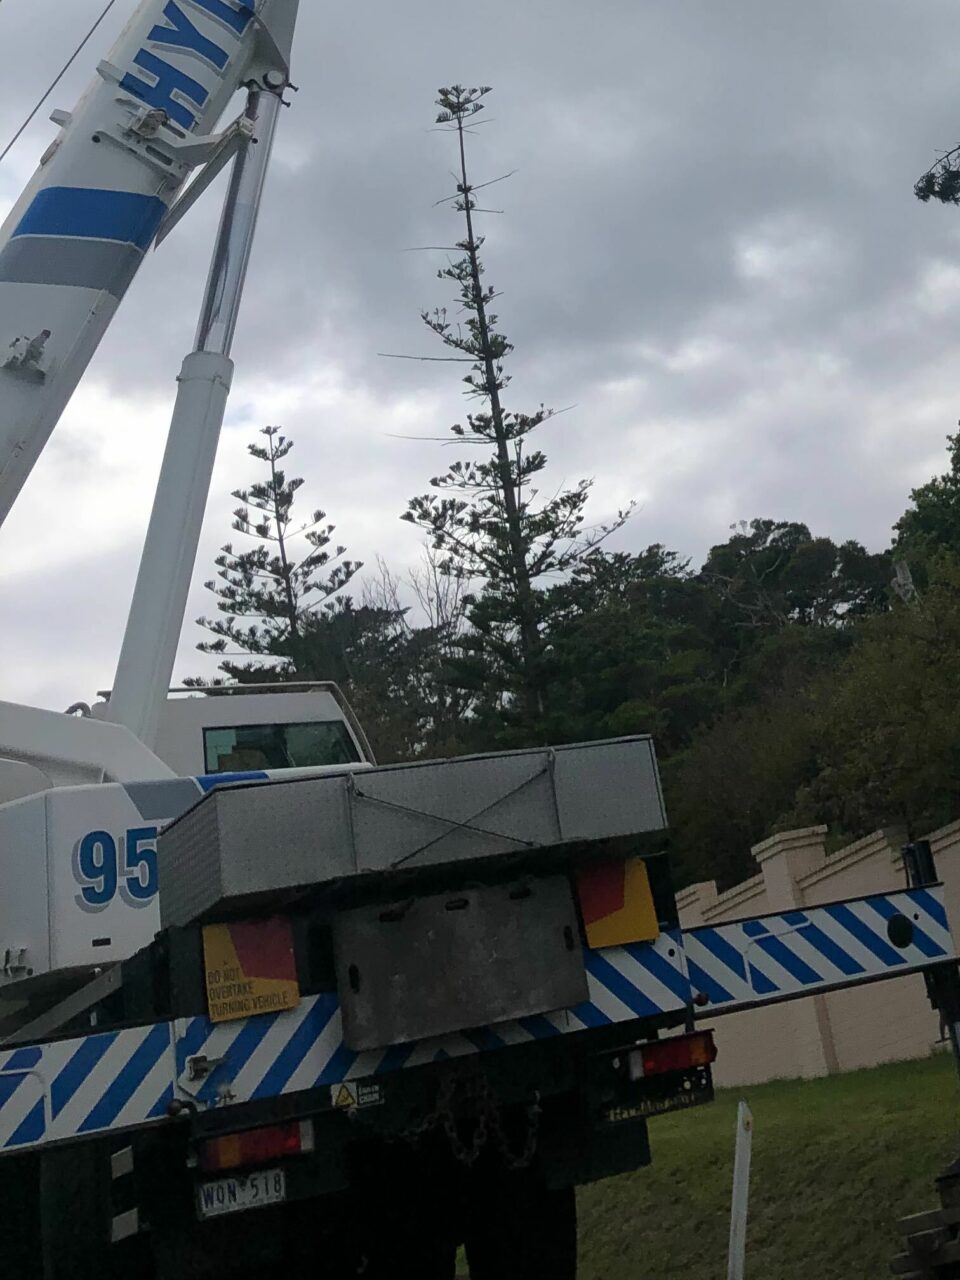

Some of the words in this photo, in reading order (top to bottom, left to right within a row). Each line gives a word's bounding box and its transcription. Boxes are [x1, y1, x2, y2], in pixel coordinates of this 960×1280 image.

[76, 826, 159, 908] 95
[208, 970, 220, 985] DO
[223, 967, 240, 982] NOT
[209, 981, 253, 1001] OVERTAKE
[210, 998, 250, 1017] TURNING
[252, 991, 289, 1009] VEHICLE
[250, 1173, 282, 1200] 518
